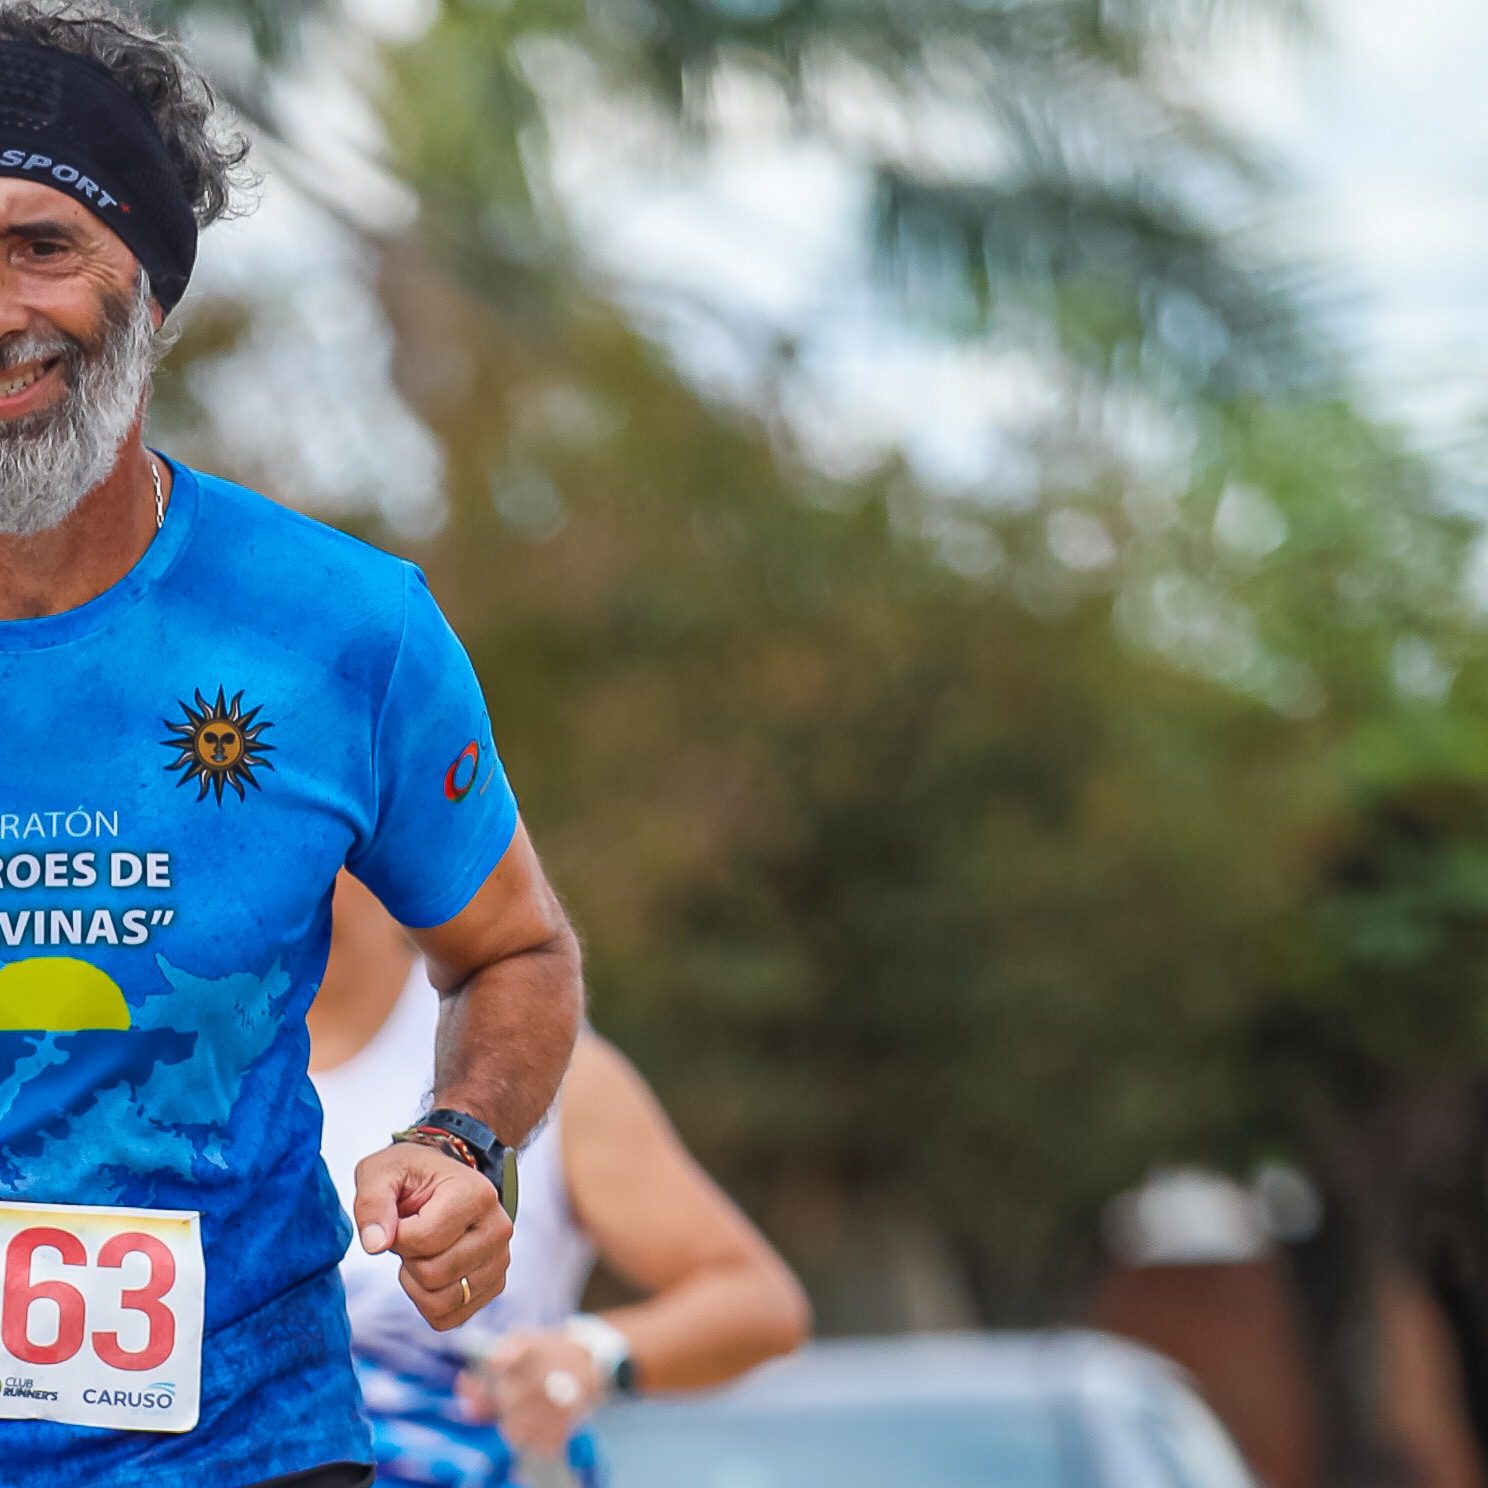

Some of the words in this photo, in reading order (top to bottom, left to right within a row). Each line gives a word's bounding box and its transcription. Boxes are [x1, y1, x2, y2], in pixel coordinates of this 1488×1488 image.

[110, 852, 171, 888] DE
[5, 1376, 34, 1388] CLUB
[82, 1388, 173, 1409] CARUSO
